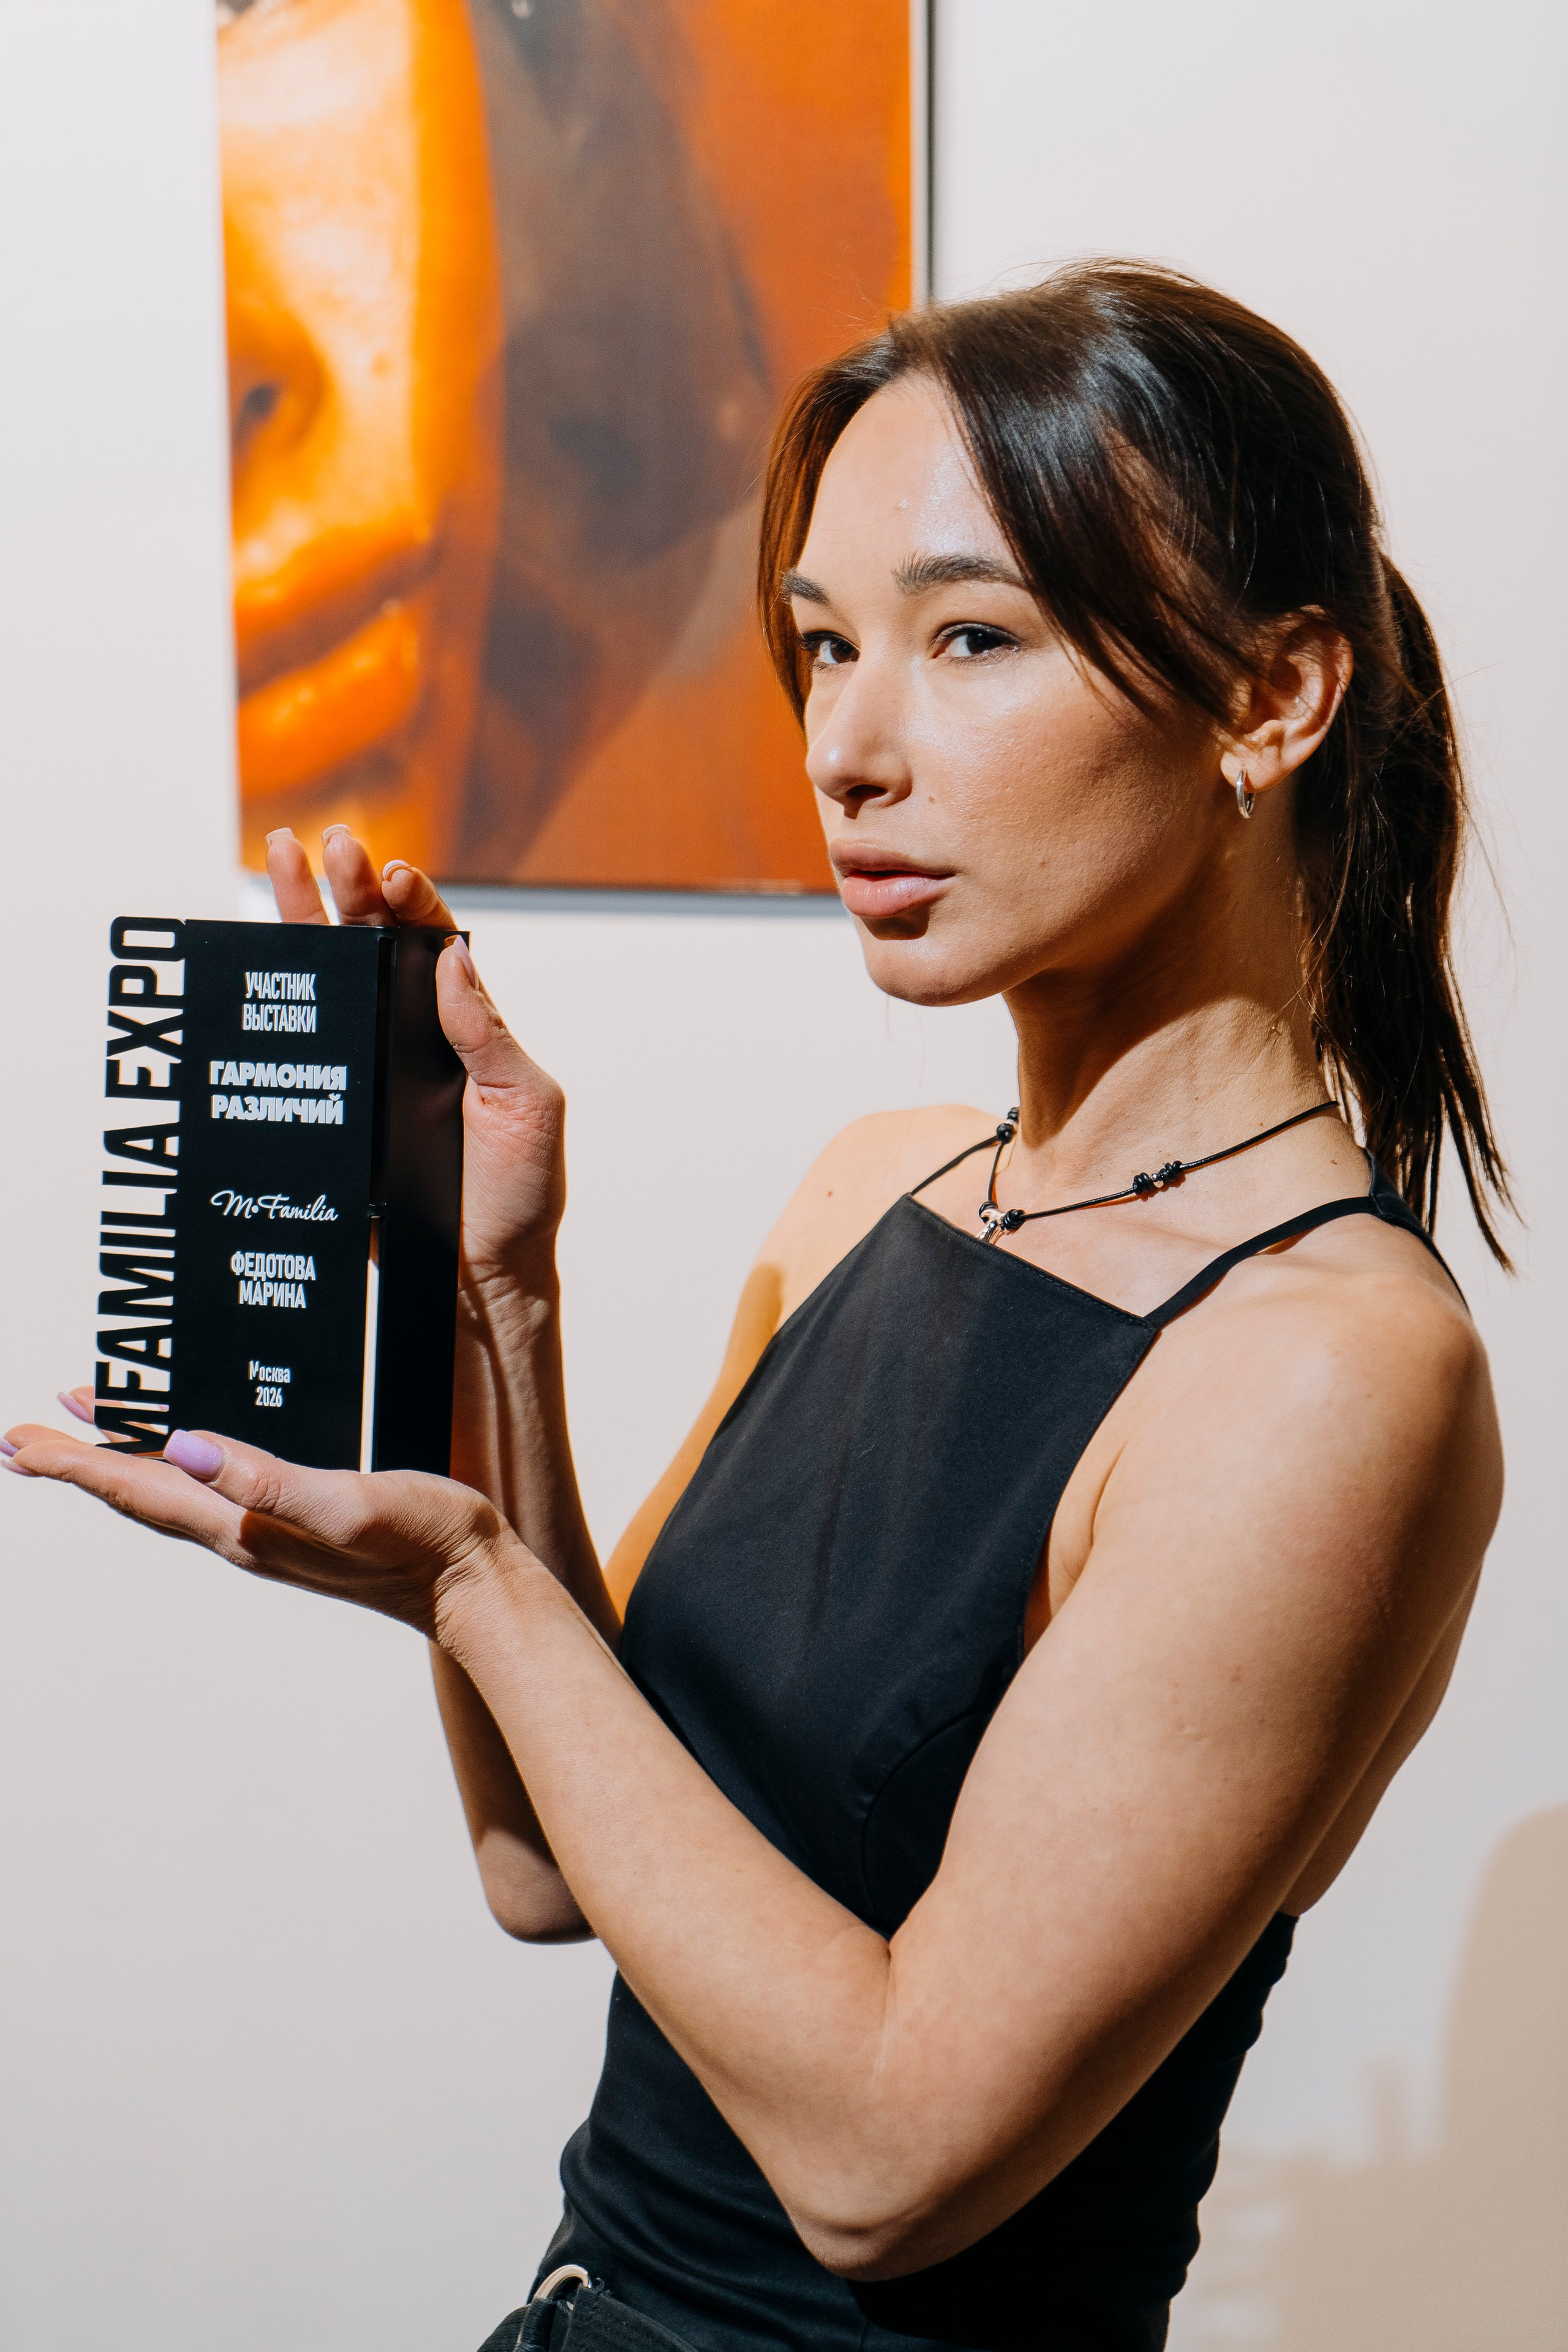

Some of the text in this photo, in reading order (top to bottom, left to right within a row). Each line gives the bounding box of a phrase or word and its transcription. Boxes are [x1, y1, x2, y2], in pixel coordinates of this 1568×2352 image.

[244, 971, 317, 1000] УЧАСТНИК
[105, 916, 186, 1101] EXPO
[242, 1003, 317, 1033] ВЫСТАВКИ
[209, 1060, 348, 1091] ГАРМОНИЯ
[211, 1093, 344, 1125] РАЗЛИЧИЙ
[230, 1251, 317, 1281] ФЕДОТОВА
[238, 1280, 307, 1309] МАРИНА
[248, 1360, 291, 1384] Москва
[255, 1385, 283, 1408] 2026
